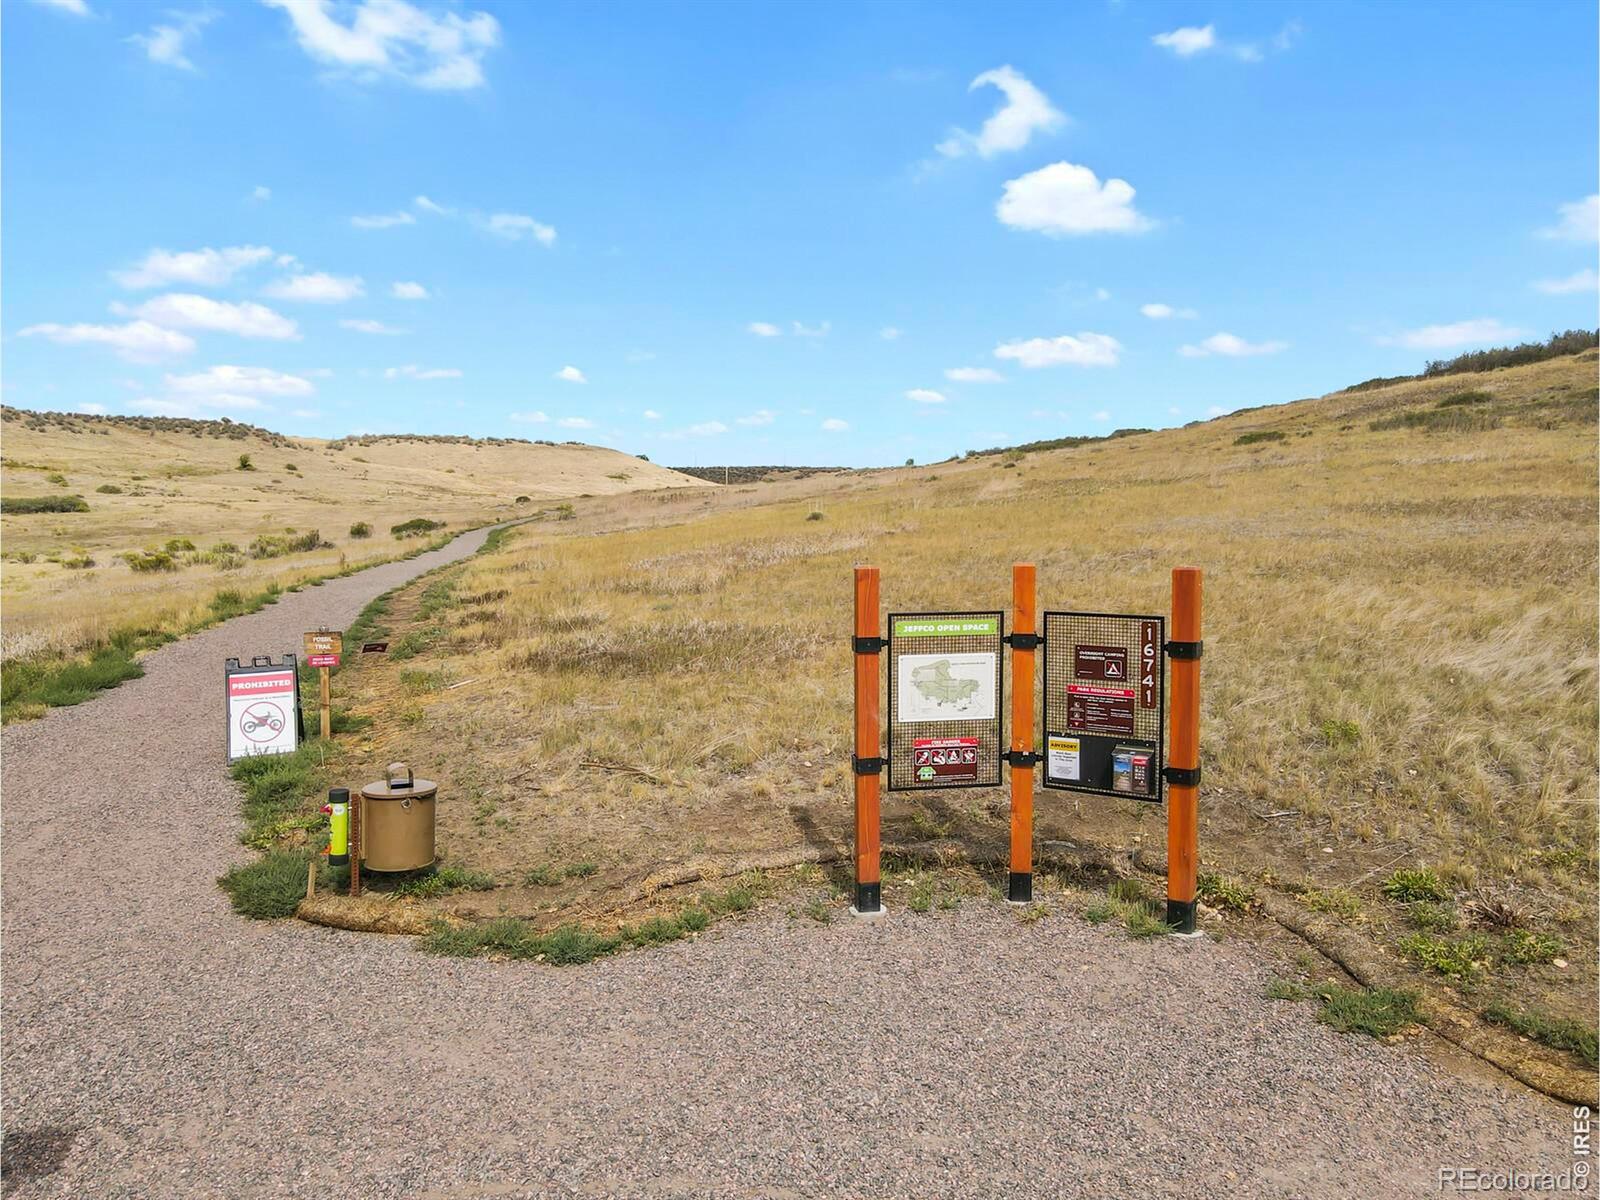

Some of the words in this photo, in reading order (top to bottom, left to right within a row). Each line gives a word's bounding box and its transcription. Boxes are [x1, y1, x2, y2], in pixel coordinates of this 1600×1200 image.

[903, 625, 935, 633] JEFFCO
[937, 624, 961, 632] OPEN
[962, 623, 989, 631] SPACE
[1142, 627, 1155, 703] 16741
[231, 679, 291, 690] PROHIBITED
